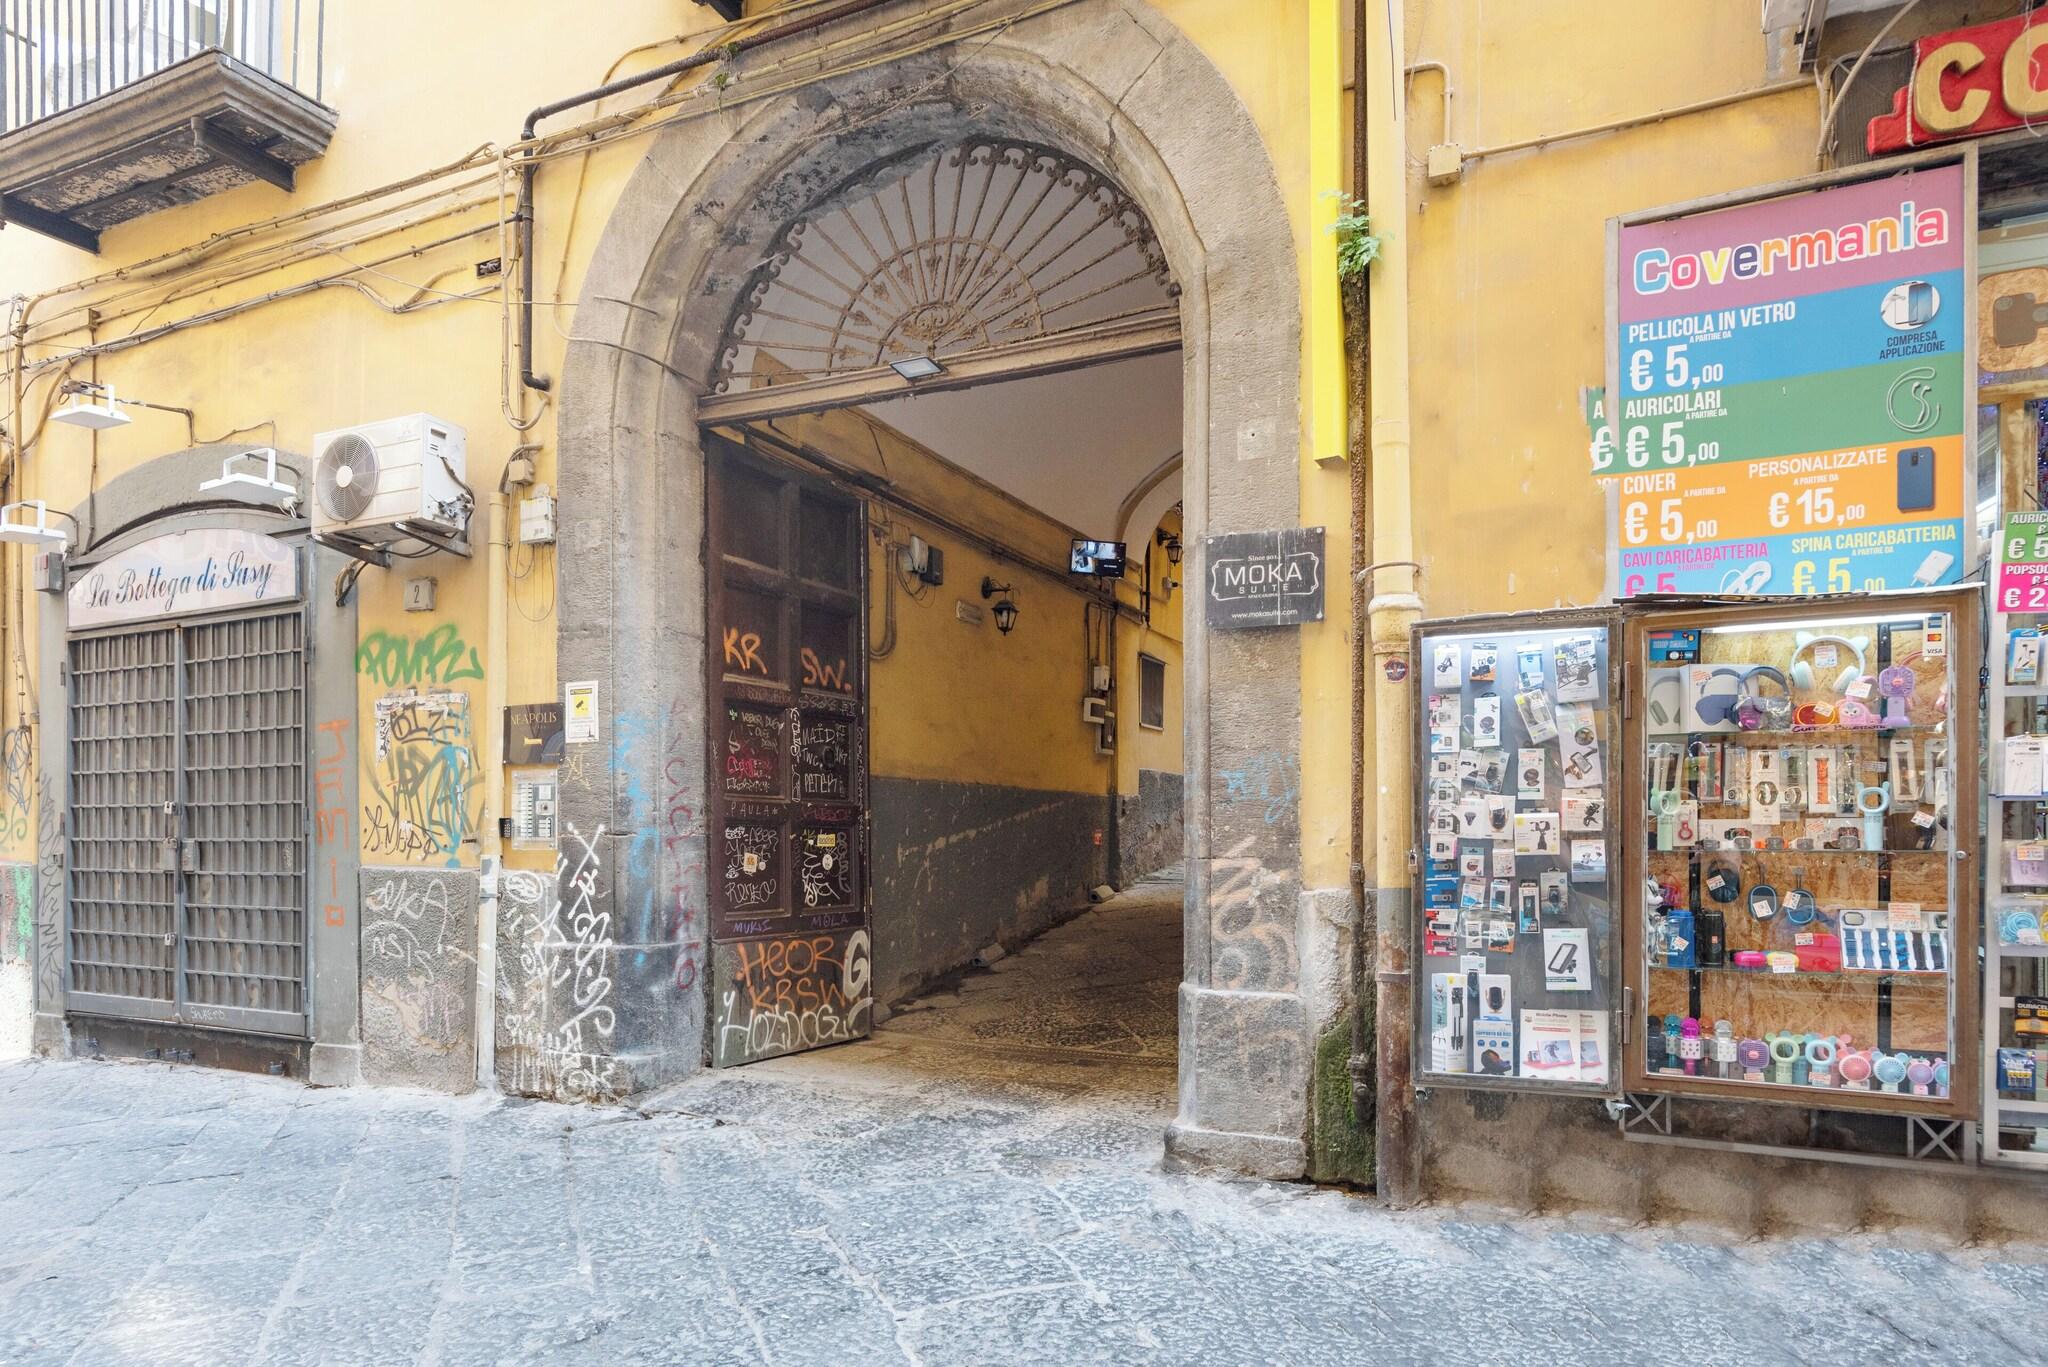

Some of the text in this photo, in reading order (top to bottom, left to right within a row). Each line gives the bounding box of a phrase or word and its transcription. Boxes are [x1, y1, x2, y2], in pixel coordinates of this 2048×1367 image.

[1634, 201, 1949, 296] Covermania
[1629, 301, 1796, 343] PELLICOLA IN VETRO
[1879, 341, 1945, 360] APPLICAZIONE
[1887, 331, 1938, 348] COMPRESA
[1630, 344, 1724, 391] € 5,00
[1625, 390, 1721, 419] AURICOLARI
[1625, 421, 1719, 468] € 5,00
[1749, 448, 1887, 478] PERSONALIZZATE
[1624, 472, 1676, 494] COVER
[1624, 498, 1718, 544] € 5,00
[1768, 487, 1865, 528] € 15,00
[1791, 524, 1956, 554] SPINA CARICABATTERIA
[1623, 542, 1769, 568] CAVI CARICABATTERIA
[87, 574, 111, 609] La
[115, 566, 193, 612] Bottega
[196, 557, 217, 592] di
[1225, 562, 1302, 587] MOKA
[1238, 583, 1289, 594] SUITE
[510, 712, 557, 727] NEAPOLIS
